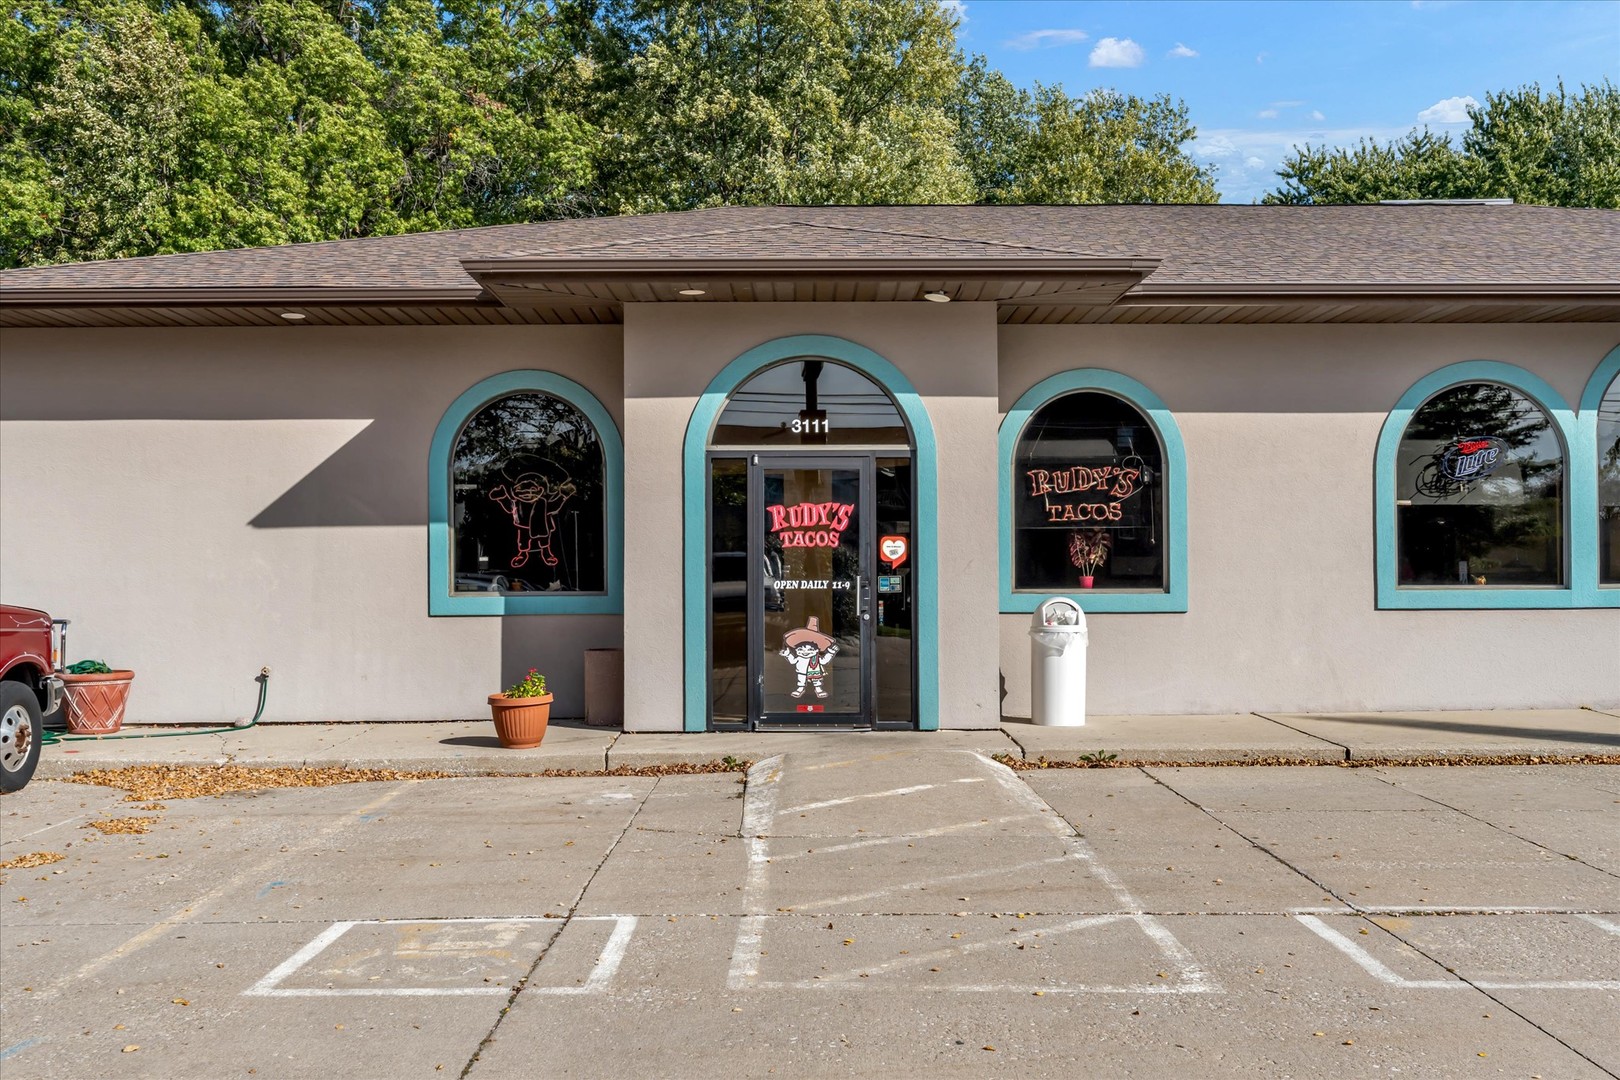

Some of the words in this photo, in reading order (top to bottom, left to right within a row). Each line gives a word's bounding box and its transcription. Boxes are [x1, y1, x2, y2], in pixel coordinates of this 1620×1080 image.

[791, 419, 830, 433] 3111
[1027, 466, 1140, 498] RUDY'S
[766, 502, 855, 532] RUDY'S
[1047, 502, 1122, 521] TACOS
[779, 531, 840, 548] TACOS
[773, 580, 799, 589] OPEN
[800, 580, 829, 589] DAILY
